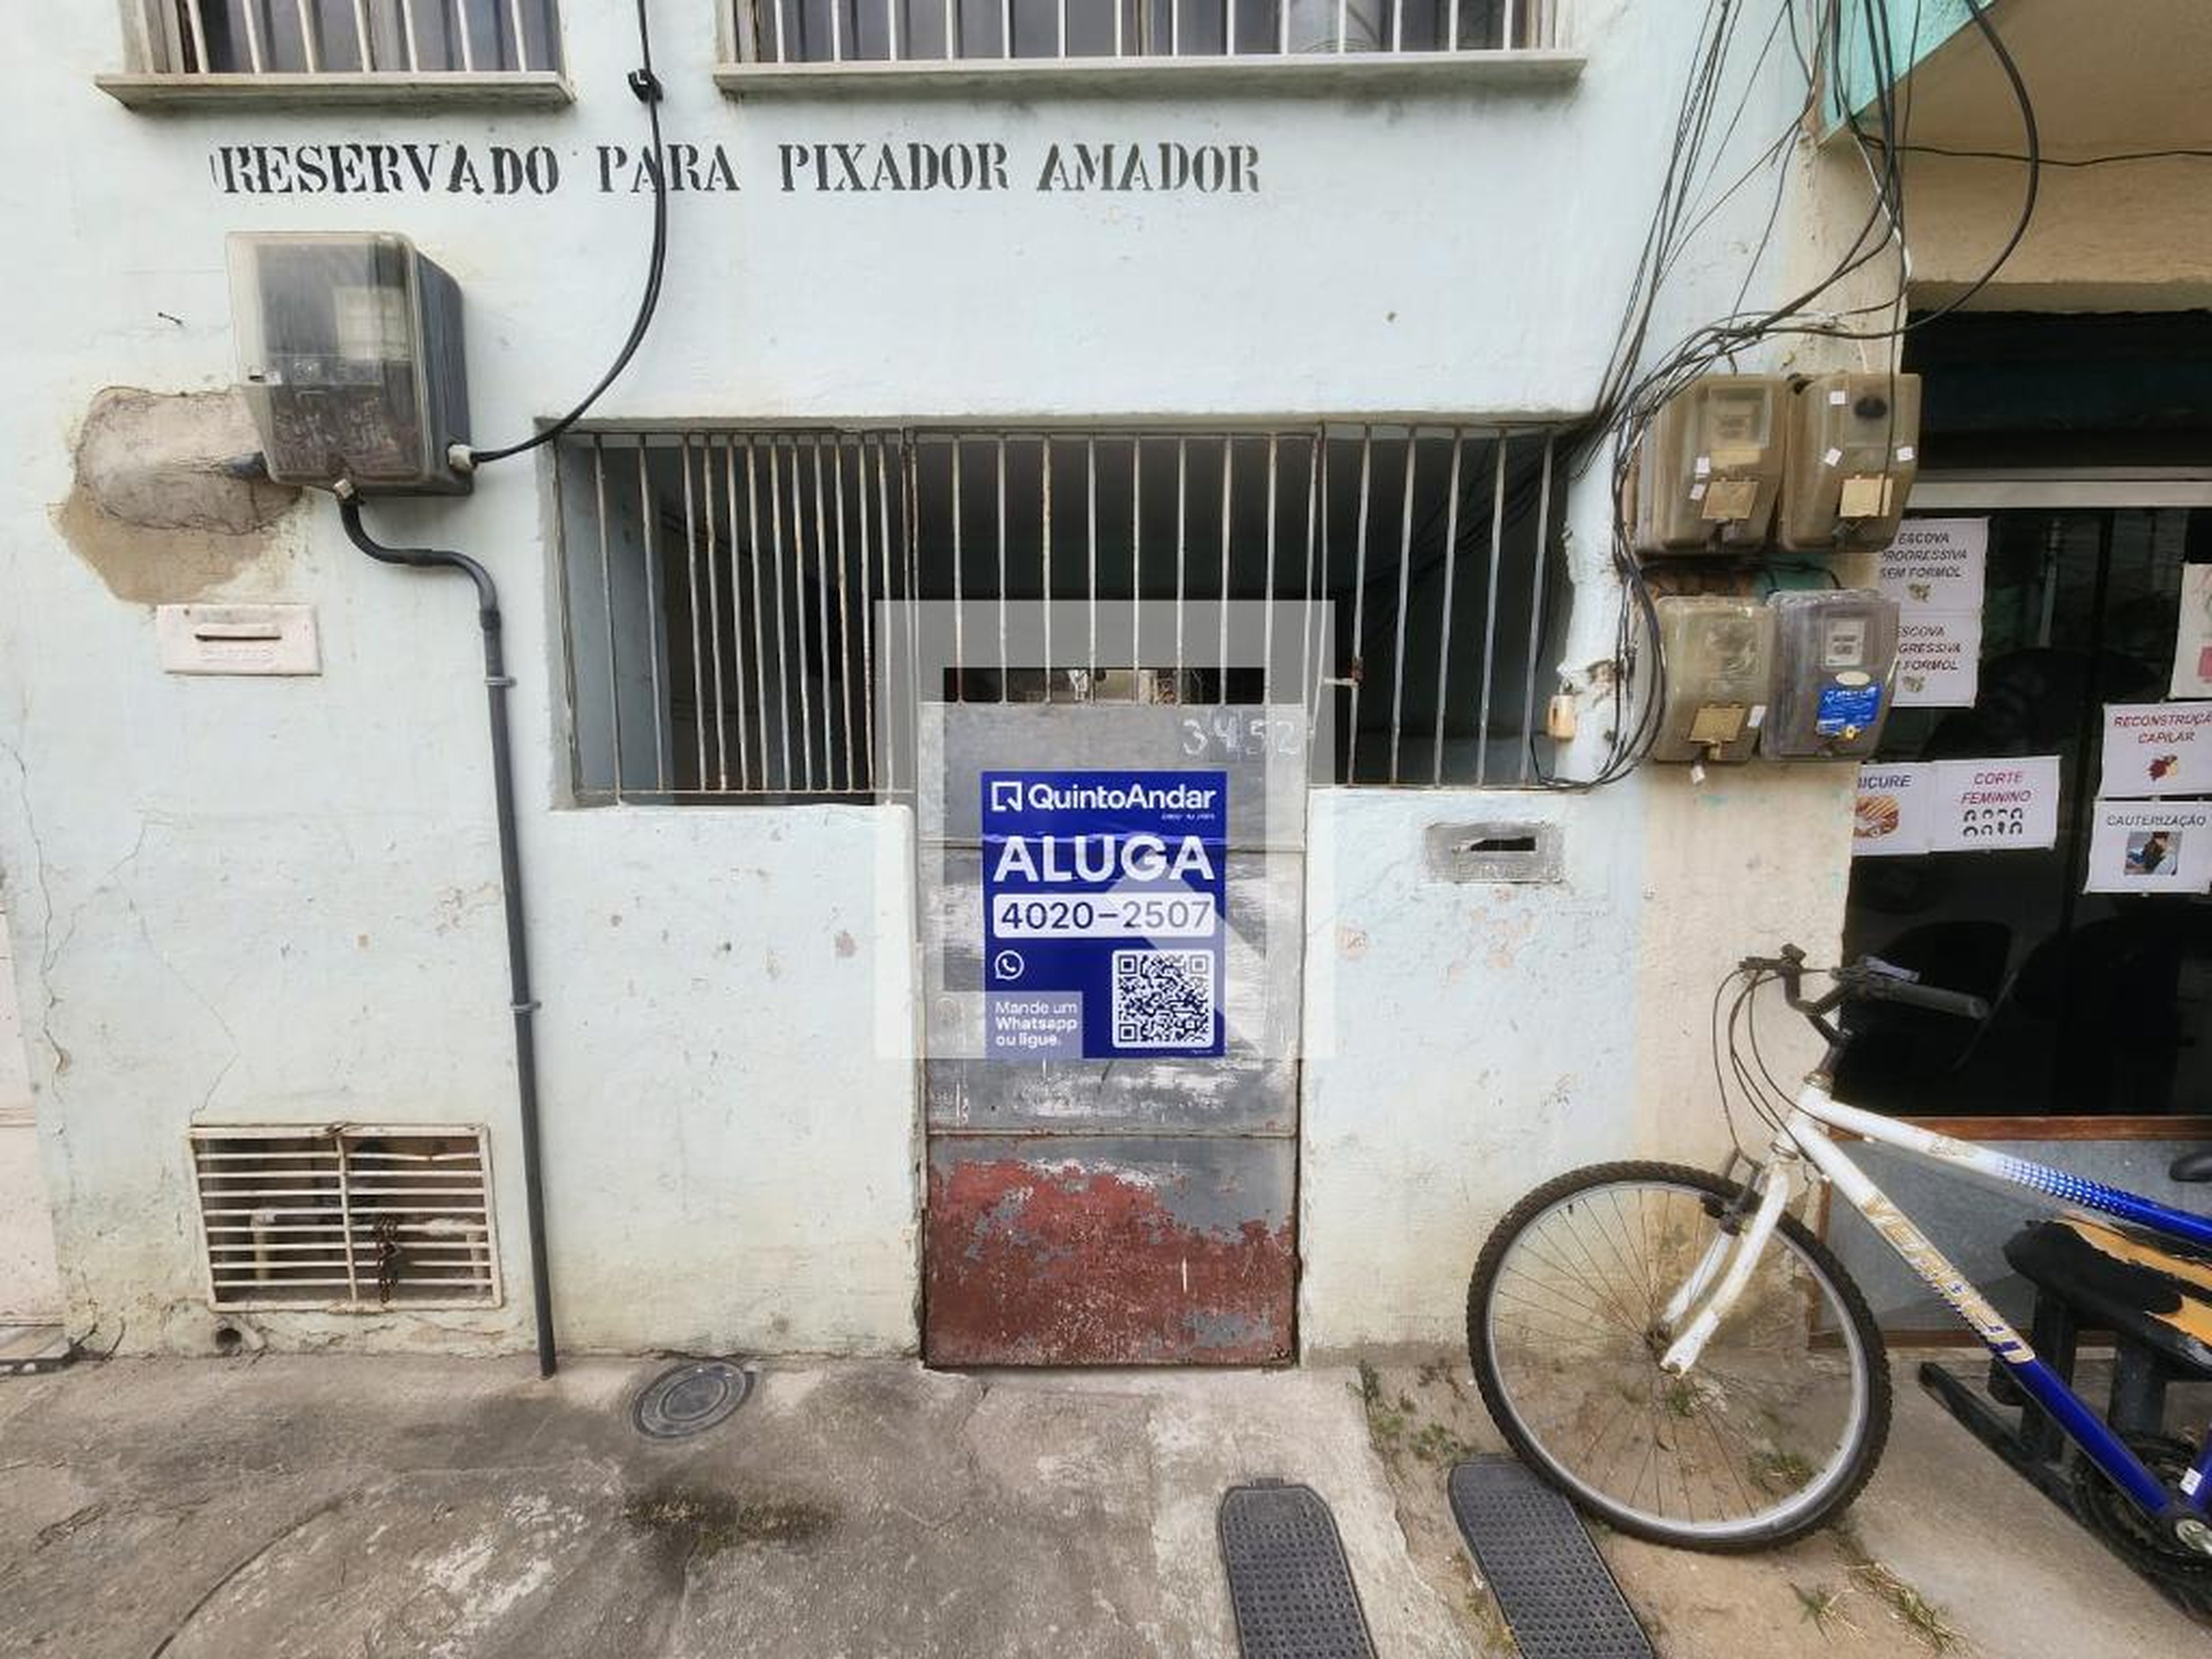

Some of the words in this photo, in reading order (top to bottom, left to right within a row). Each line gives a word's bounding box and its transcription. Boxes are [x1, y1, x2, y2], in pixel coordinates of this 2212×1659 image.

[219, 145, 559, 194] RESERVADO
[596, 144, 740, 192] PARA
[778, 142, 1009, 192] PIXADOR
[1037, 142, 1261, 193] AMADOR
[1898, 532, 1950, 544] ESCOVA
[1910, 565, 1961, 578] FORMOL
[1899, 641, 1960, 653] GRESSIVA
[1903, 658, 1959, 671] FORMOL
[2138, 732, 2195, 744] CAPILAR
[1974, 771, 2023, 785] CORTE
[1028, 783, 1217, 811] QuintoAndar
[1960, 790, 2032, 804] FEMININO
[993, 835, 1215, 882] ALUGA
[1001, 900, 1211, 930] 4020-2507
[995, 1000, 1050, 1014] Mande
[1053, 1002, 1078, 1014] um
[995, 1016, 1078, 1033] Whatsapp
[995, 1035, 1017, 1046] ou
